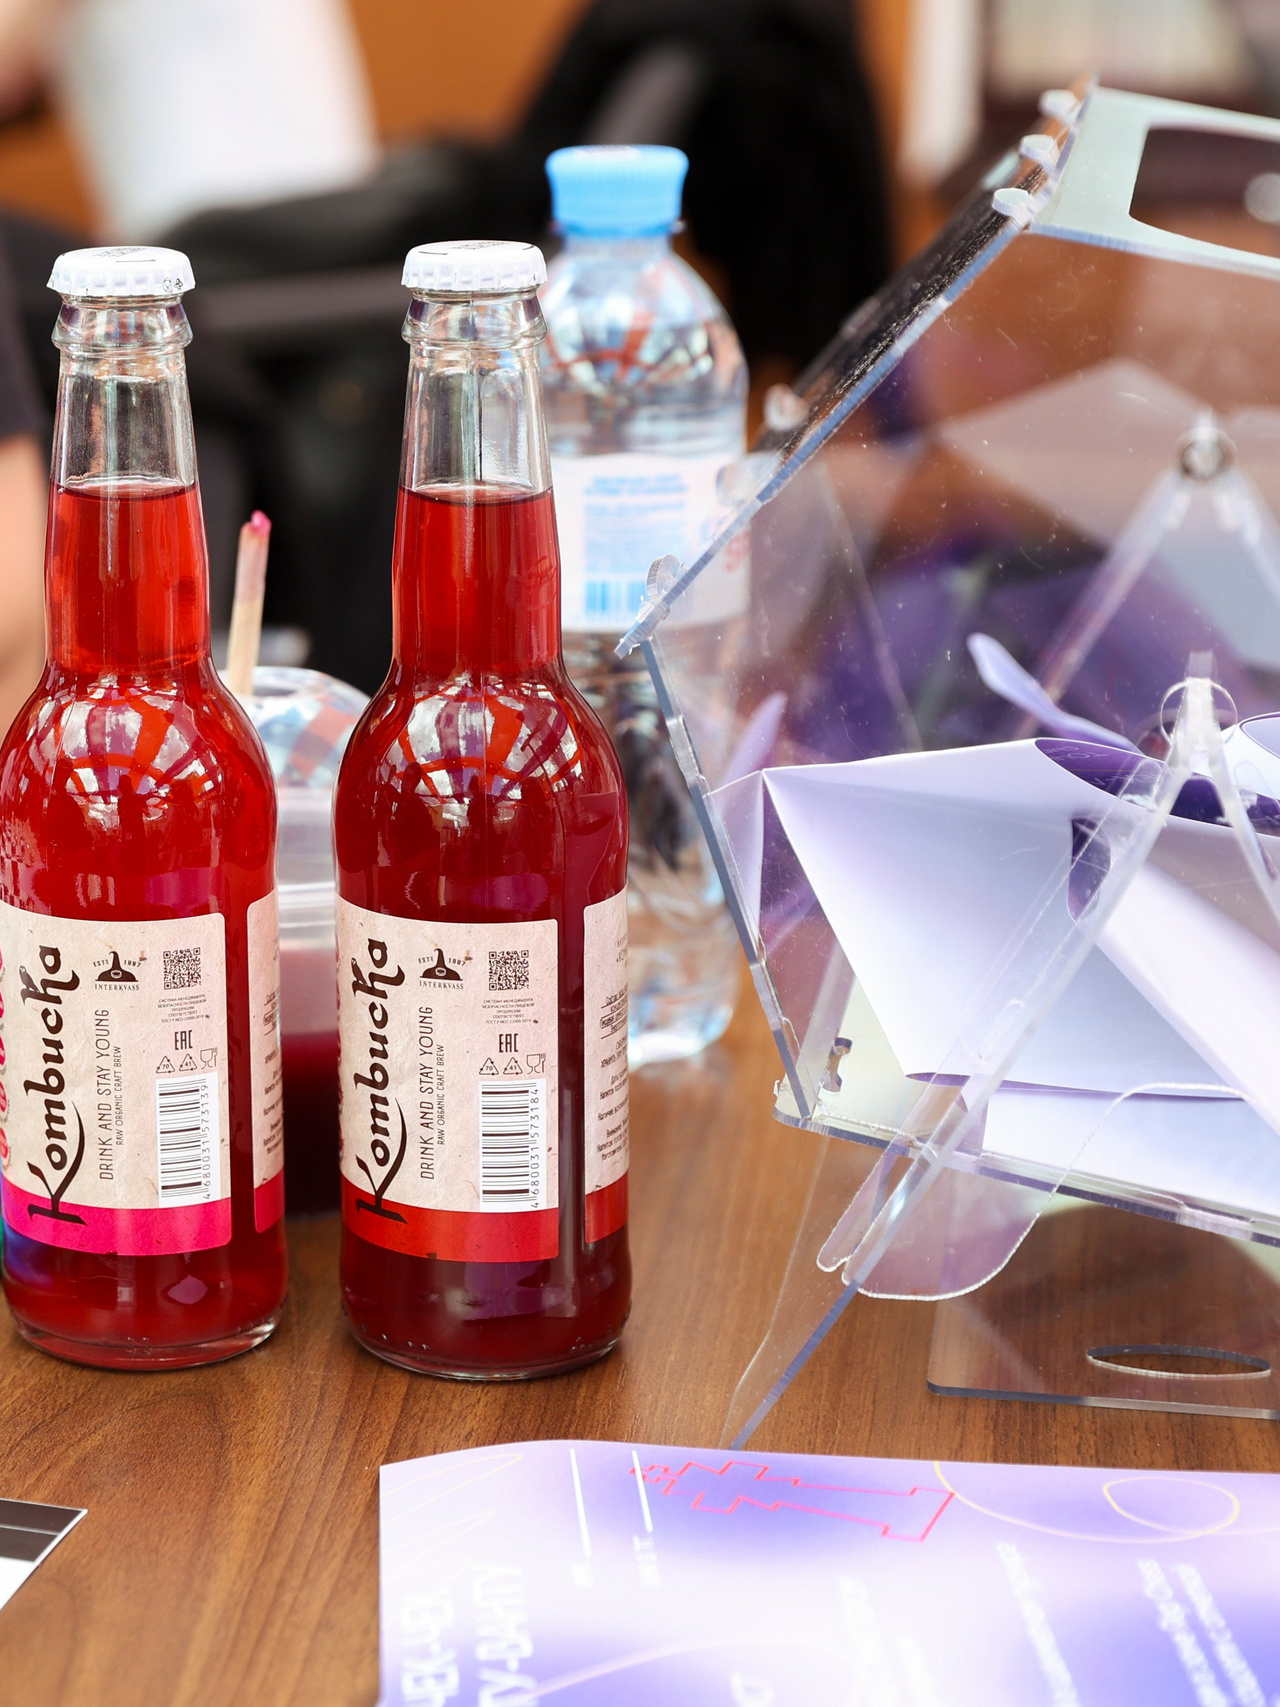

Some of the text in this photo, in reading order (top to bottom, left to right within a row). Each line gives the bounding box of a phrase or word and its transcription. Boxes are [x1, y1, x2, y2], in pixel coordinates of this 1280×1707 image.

[95, 983, 140, 991] INTERKVASS
[419, 980, 464, 990] INTERKVASS
[20, 945, 87, 1226] Kombucha
[94, 1009, 114, 1180] DRINK AND STAY YOUNG
[113, 1046, 124, 1146] RAW ORGANIC CRAFT BREW
[351, 938, 408, 1225] Kombucha
[418, 1006, 434, 1180] DRINK AND STAY YOUNG
[436, 1044, 445, 1146] RAW ORGANIC CRAFT BREW
